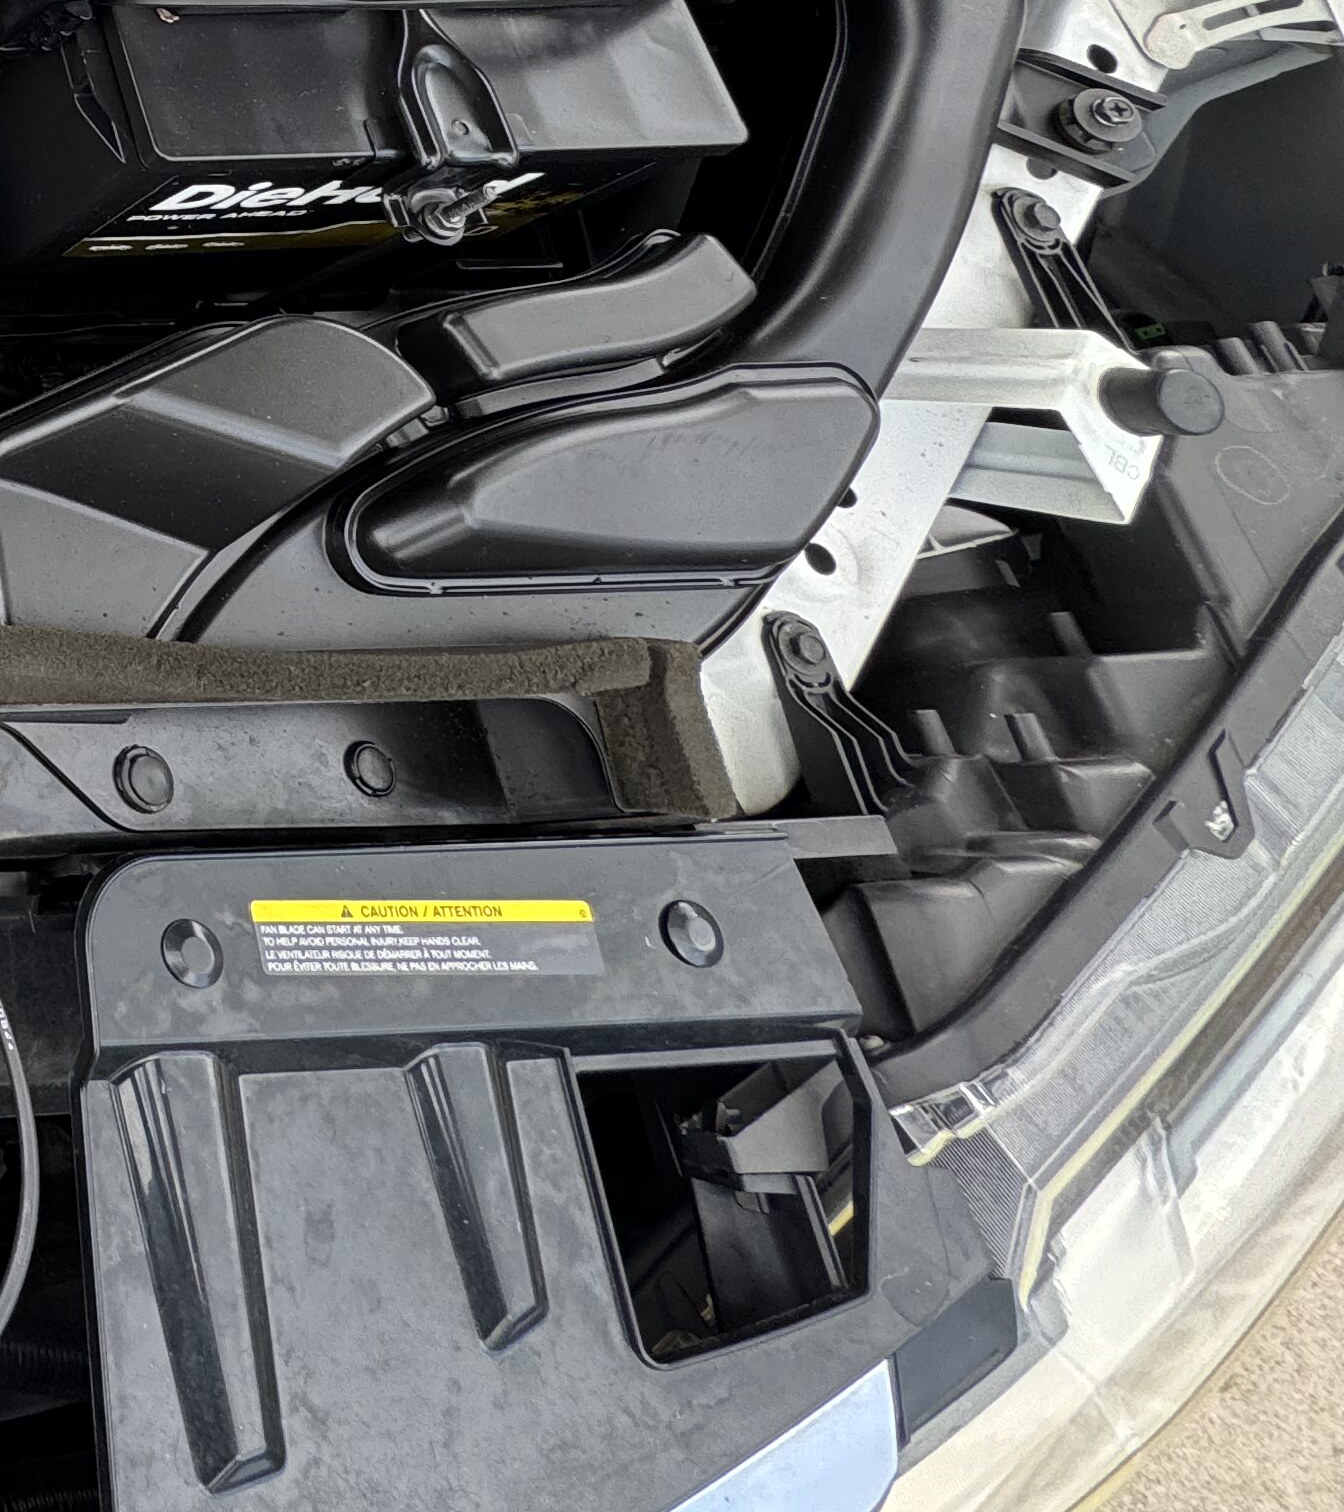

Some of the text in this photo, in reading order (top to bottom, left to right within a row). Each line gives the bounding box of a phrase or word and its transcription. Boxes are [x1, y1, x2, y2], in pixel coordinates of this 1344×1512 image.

[126, 209, 307, 222] POWER AHEAD
[360, 905, 419, 918] CAUTION
[433, 905, 503, 918] ATTENTION
[260, 925, 278, 935] FAN
[278, 925, 305, 935] BLADE
[307, 925, 325, 935] CAN
[326, 925, 351, 935] START
[353, 925, 363, 935] AT
[365, 925, 381, 935] ANY
[262, 937, 275, 947] TO
[276, 937, 297, 947] HELP
[298, 937, 324, 947] AVOID
[325, 937, 370, 947] PERSONAL
[421, 937, 450, 947] HANDS
[364, 949, 377, 959] DE
[431, 949, 452, 959] TOUT
[268, 961, 293, 972] POUR
[322, 961, 349, 972] TOUTE
[397, 961, 410, 972] NE
[411, 961, 427, 972] PAS
[427, 961, 440, 972] EN
[441, 961, 492, 972] APPROCHER
[493, 961, 508, 972] LES
